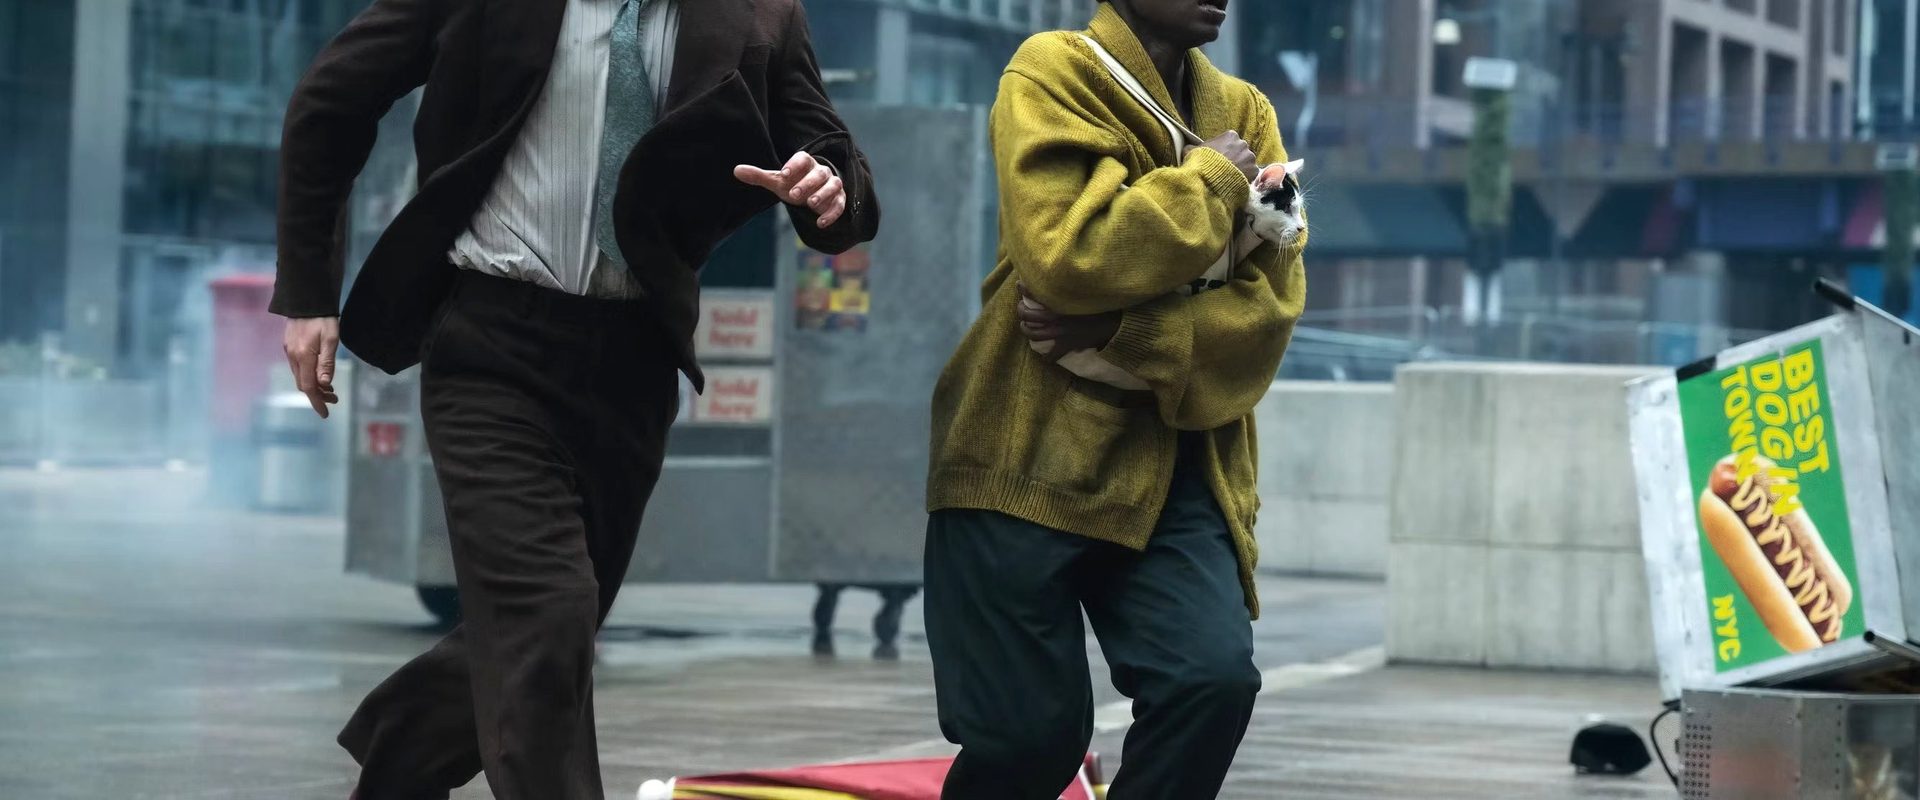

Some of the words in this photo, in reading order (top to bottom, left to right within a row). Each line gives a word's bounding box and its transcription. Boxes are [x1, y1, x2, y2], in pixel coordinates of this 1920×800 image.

[1721, 365, 1759, 485] TOWN
[1751, 359, 1795, 461] DOG
[1783, 348, 1830, 474] BEST
[1768, 467, 1802, 516] IN
[1712, 593, 1741, 662] NYC
